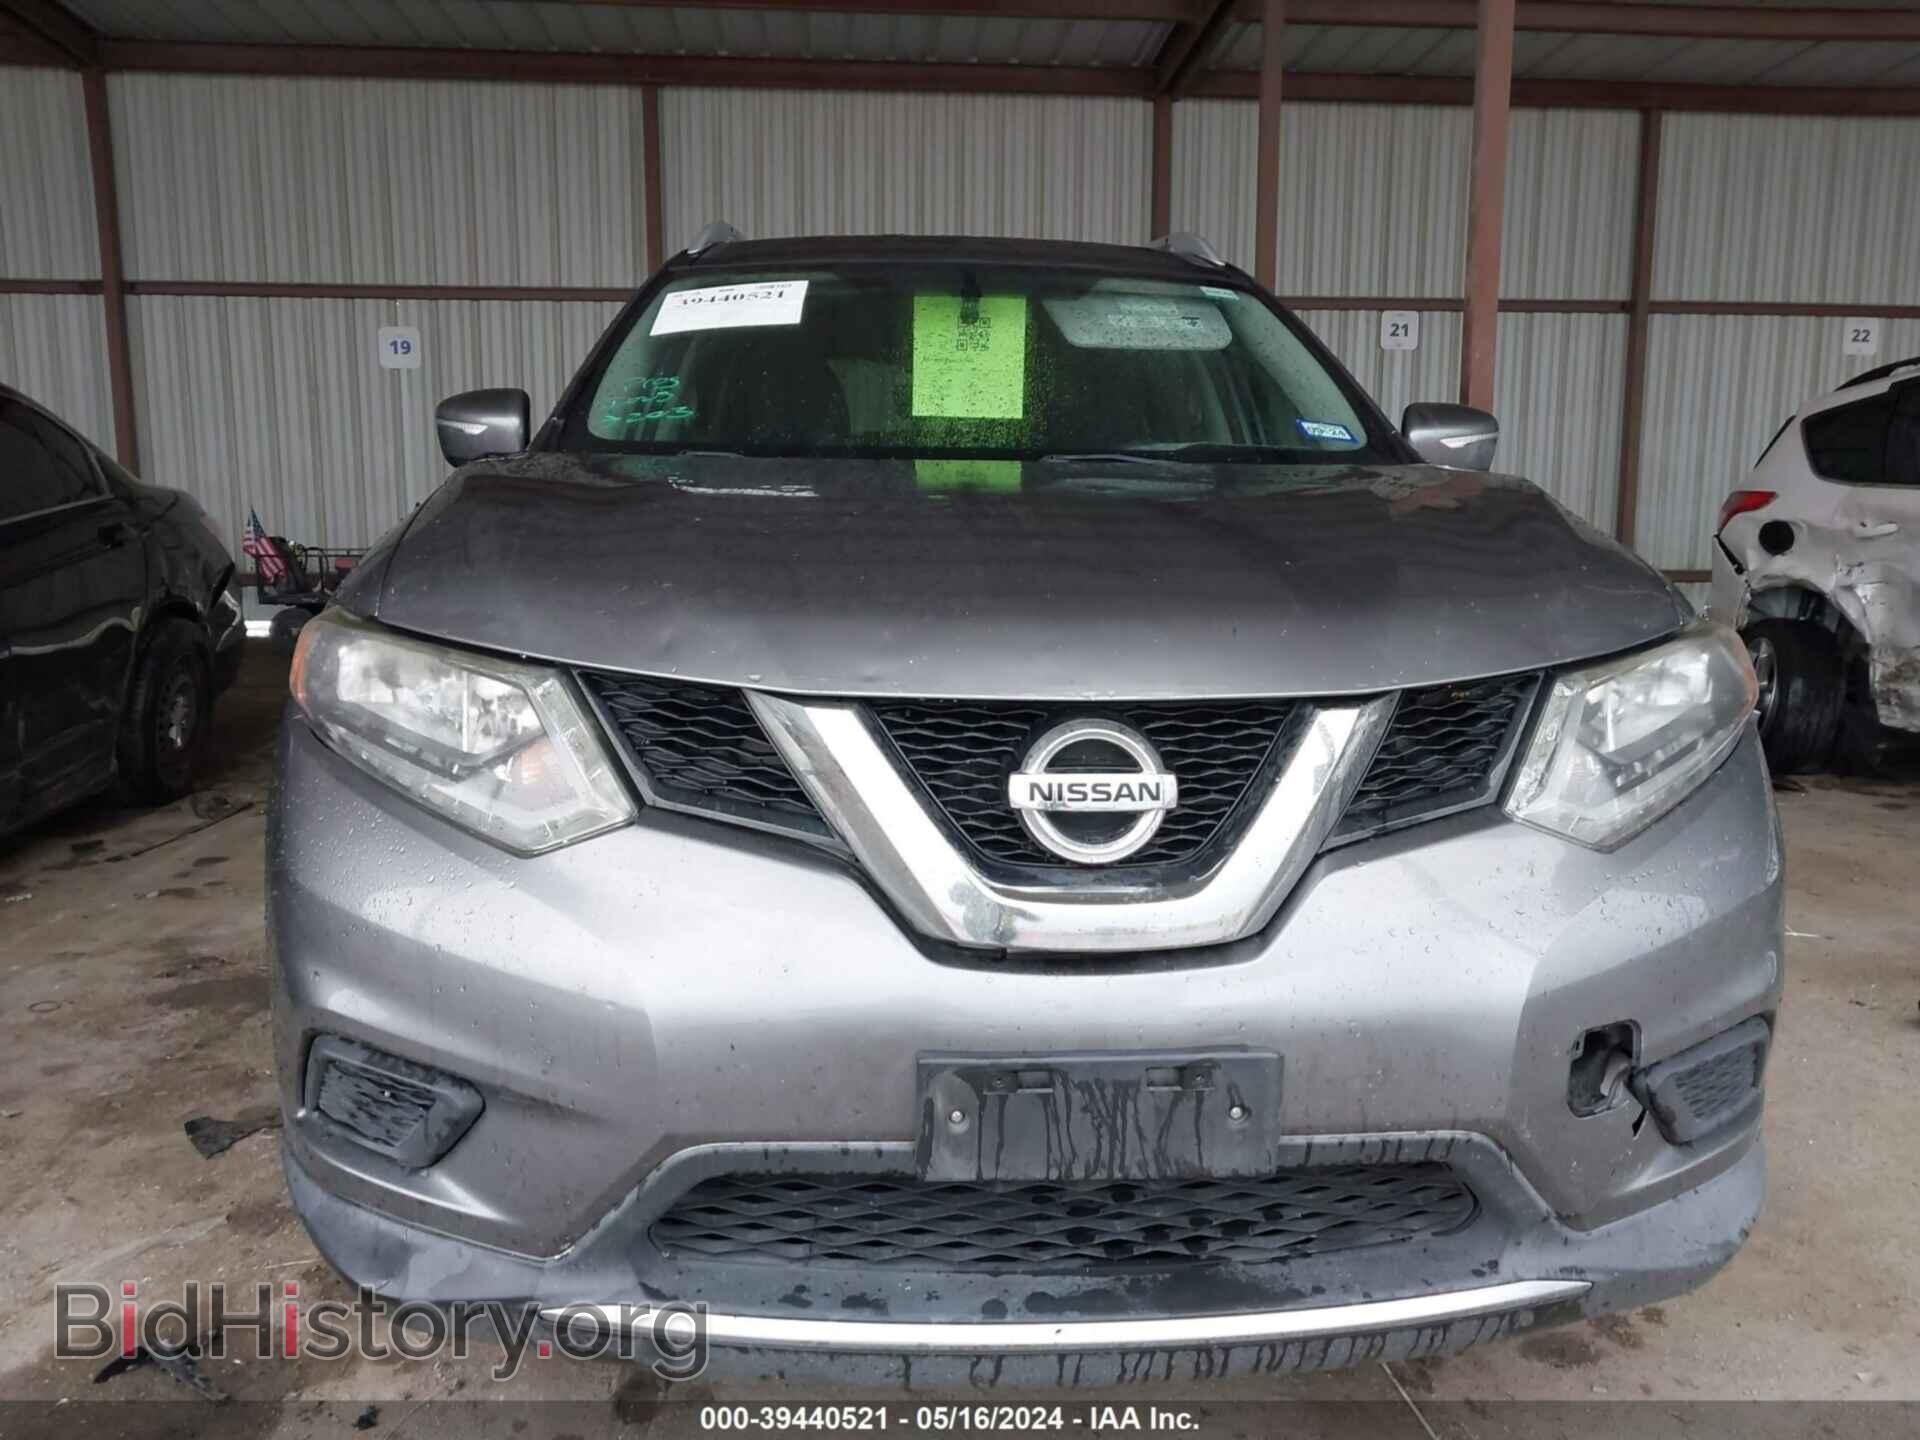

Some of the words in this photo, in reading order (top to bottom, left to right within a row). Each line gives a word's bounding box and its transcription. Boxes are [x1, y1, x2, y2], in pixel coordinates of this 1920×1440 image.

[1390, 323, 1409, 337] 21
[1851, 328, 1871, 343] 22
[389, 339, 412, 355] 19
[1029, 782, 1161, 803] NISSAN
